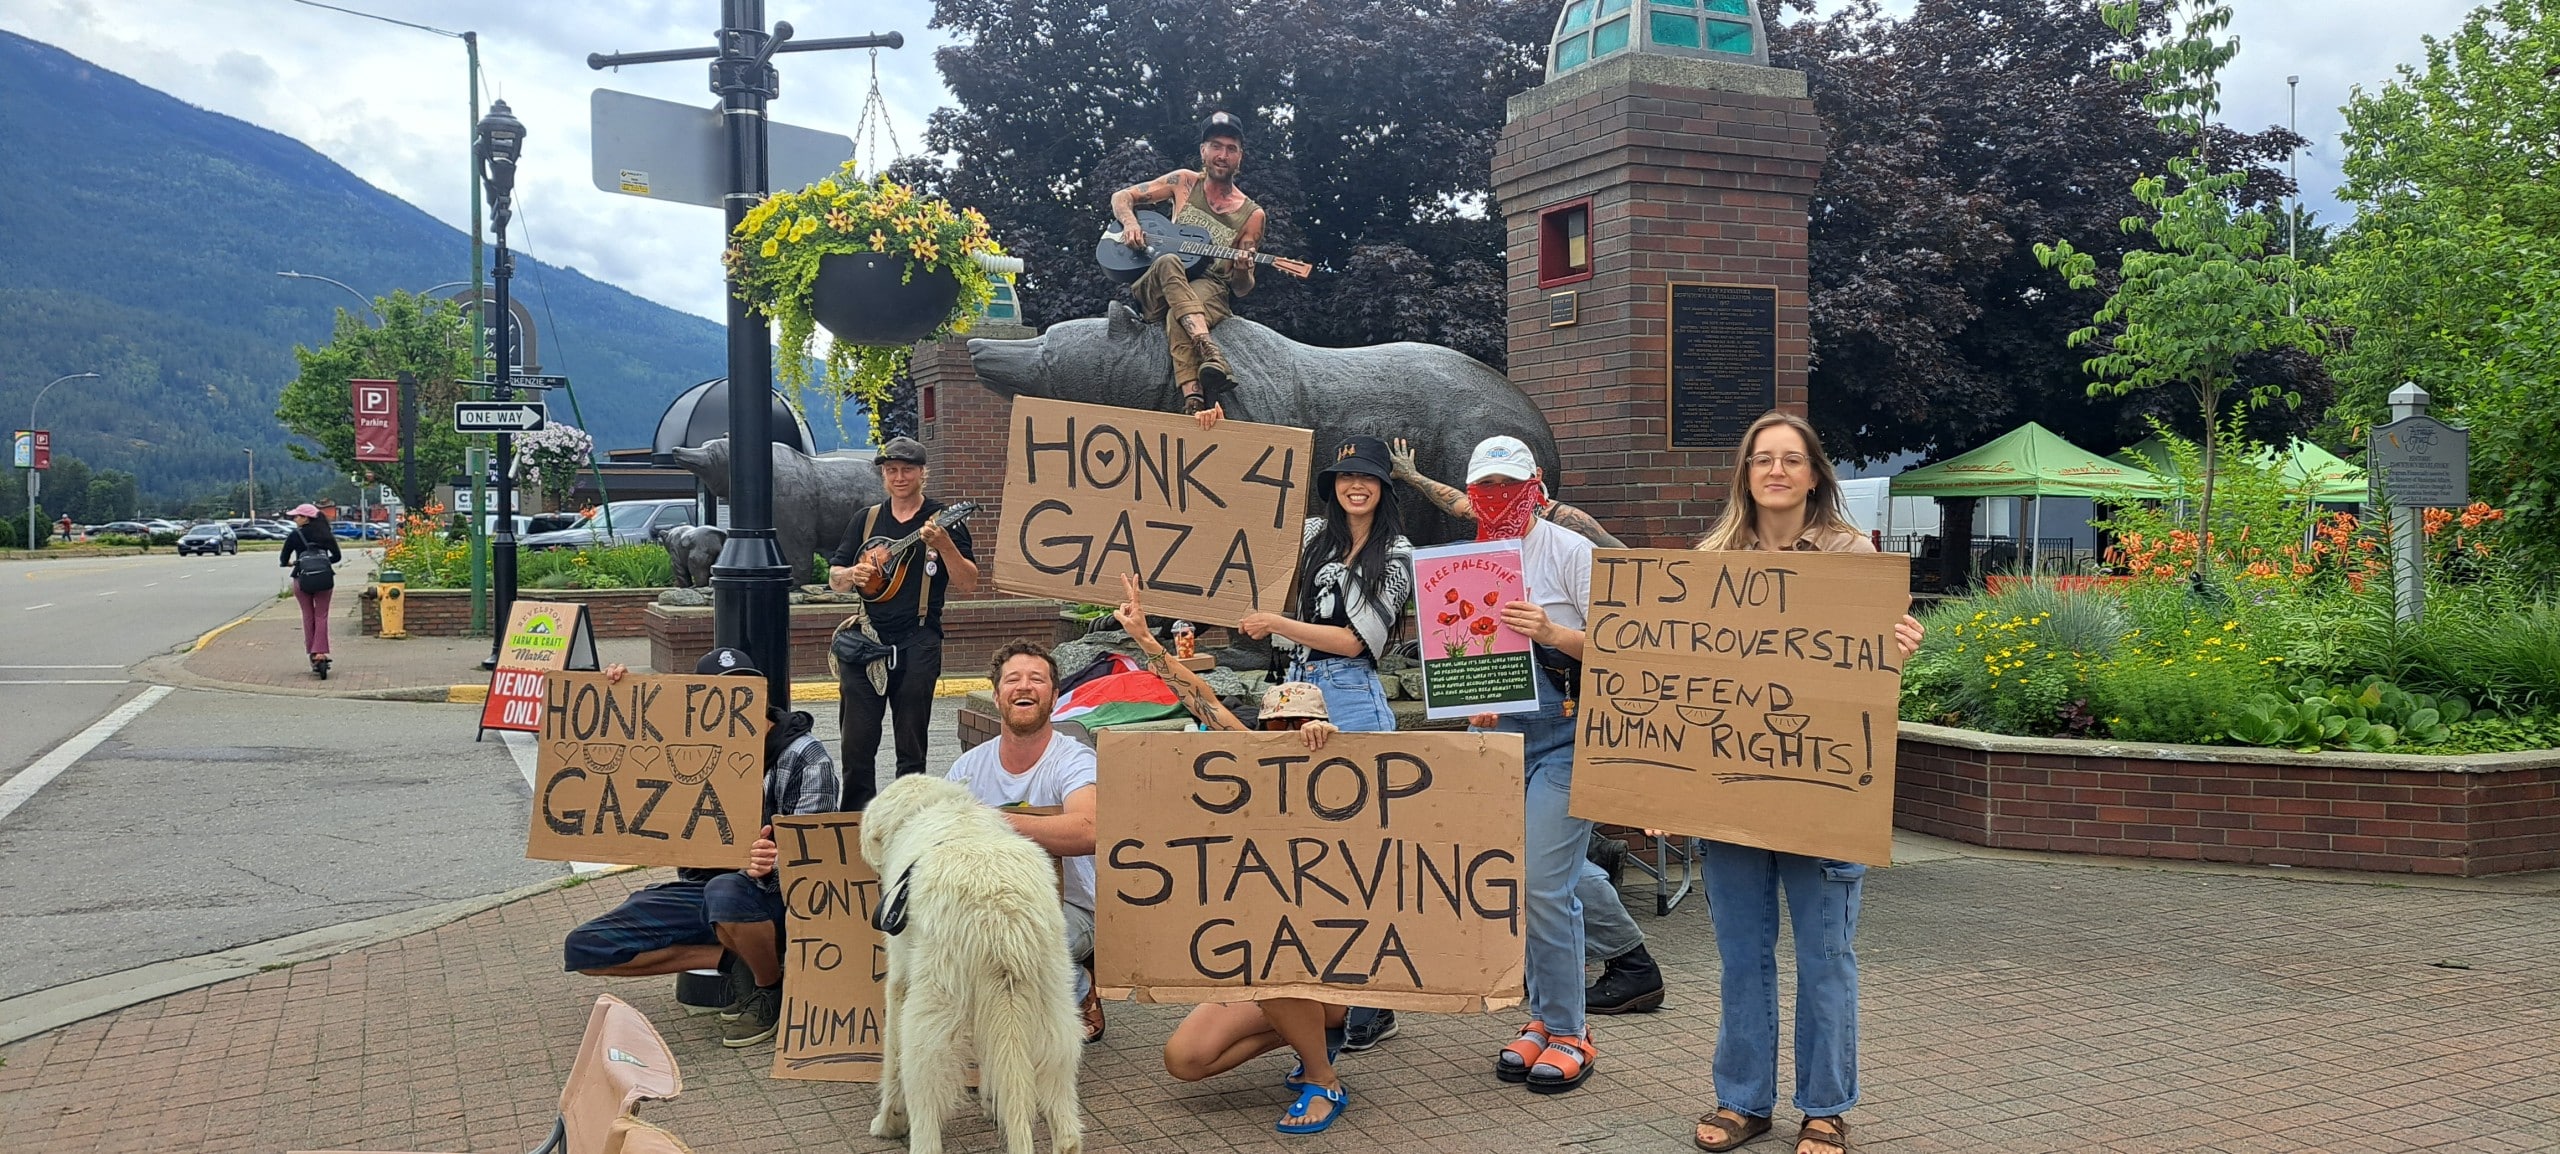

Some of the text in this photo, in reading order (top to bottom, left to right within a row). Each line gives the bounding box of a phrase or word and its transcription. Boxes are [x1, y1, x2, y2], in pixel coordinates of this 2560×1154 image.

[361, 418, 388, 428] Parking
[367, 392, 382, 409] P
[466, 412, 522, 423] ONE WAY
[1025, 415, 1295, 529] HONK 4
[1019, 499, 1259, 612] GAZA
[1424, 558, 1516, 592] FREE PALESTINE
[1593, 557, 1798, 614] IT'S NOT
[518, 606, 563, 630] REVELSTOKE
[511, 648, 556, 662] Market
[512, 635, 563, 647] FARM & CRAFT
[1593, 612, 1901, 675] CONTROVERSIAL
[494, 672, 544, 698] VENDO
[1589, 668, 1794, 712] TO DEFEND
[503, 700, 542, 726] ONLY
[546, 679, 758, 742] HONK FOR
[1585, 707, 1874, 787] HUMAN RIGHTS!
[542, 766, 734, 845] GAZA
[1190, 750, 1434, 829] STOP
[787, 876, 883, 921] CONT
[1108, 836, 1520, 937] STARVING
[791, 938, 887, 983] TO D
[1189, 915, 1424, 990] GAZA
[784, 997, 886, 1053] HUMA
